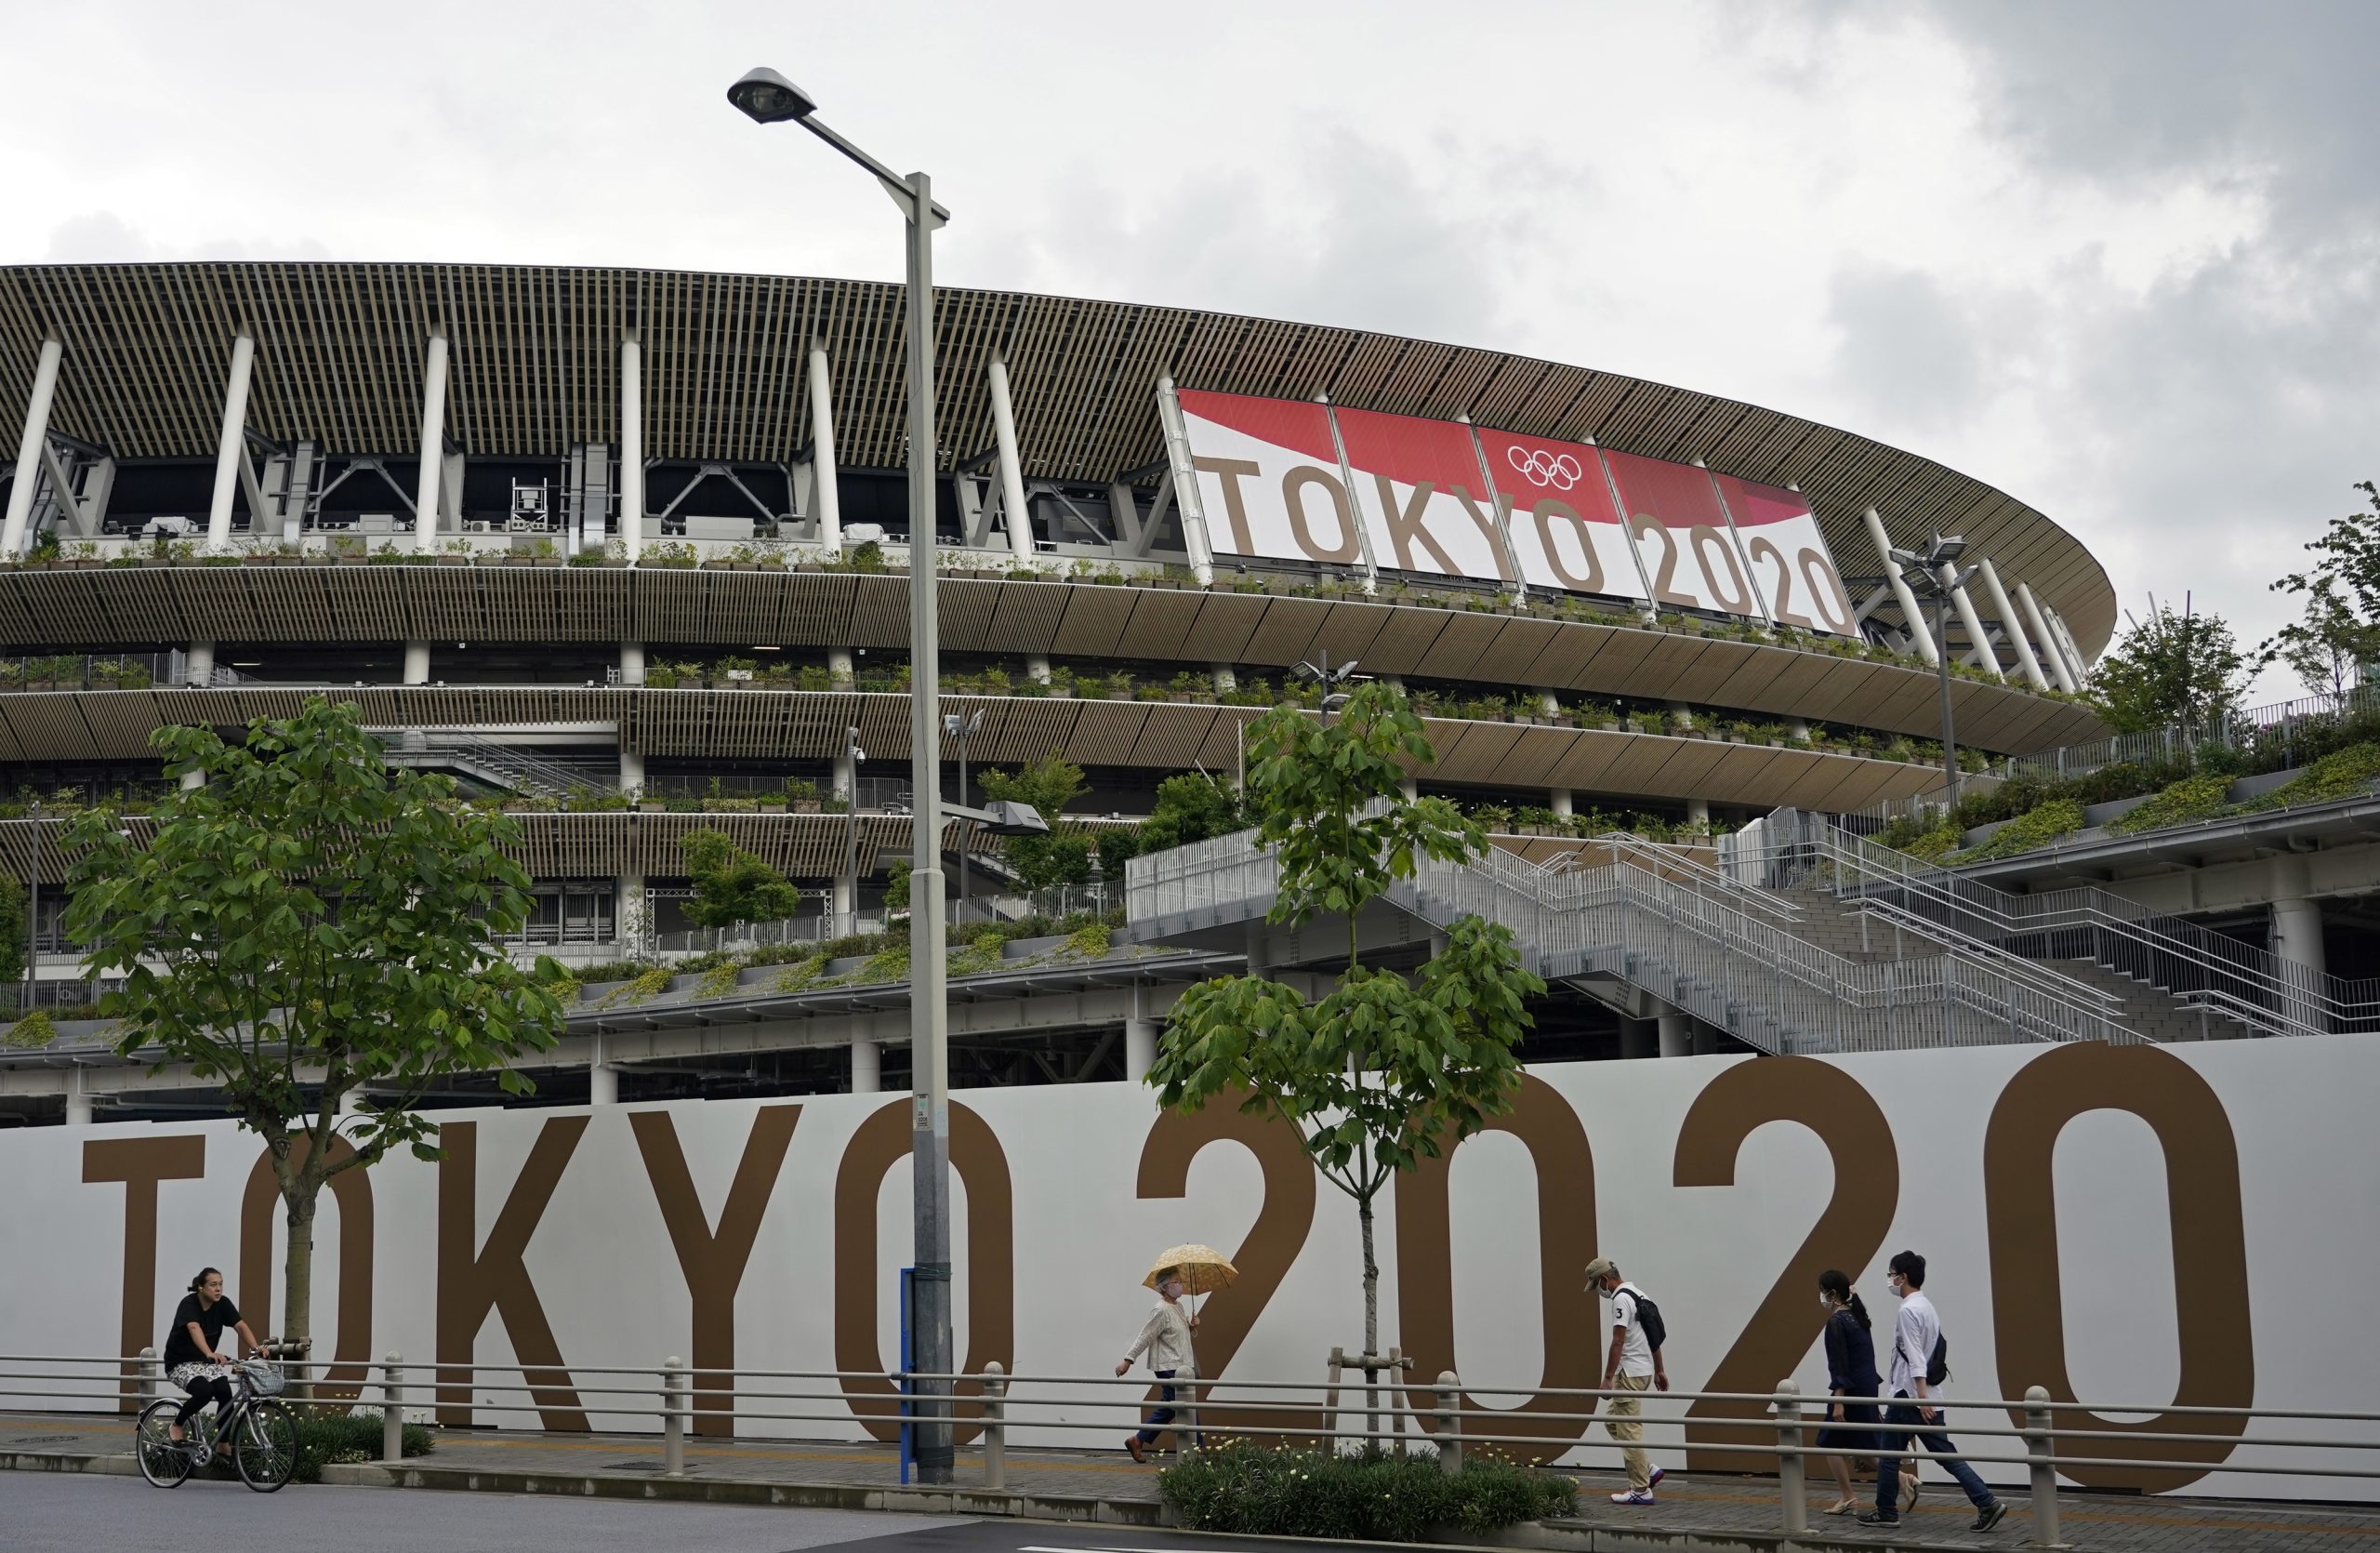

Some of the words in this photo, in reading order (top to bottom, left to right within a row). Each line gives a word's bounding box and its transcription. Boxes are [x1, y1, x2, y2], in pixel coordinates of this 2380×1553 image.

[1192, 455, 1605, 593] TOKYO
[1632, 512, 1856, 637] 2020
[83, 1097, 1013, 1444] TOKYO
[1136, 1041, 2254, 1492] 2020
[1616, 1307, 1623, 1320] 3
